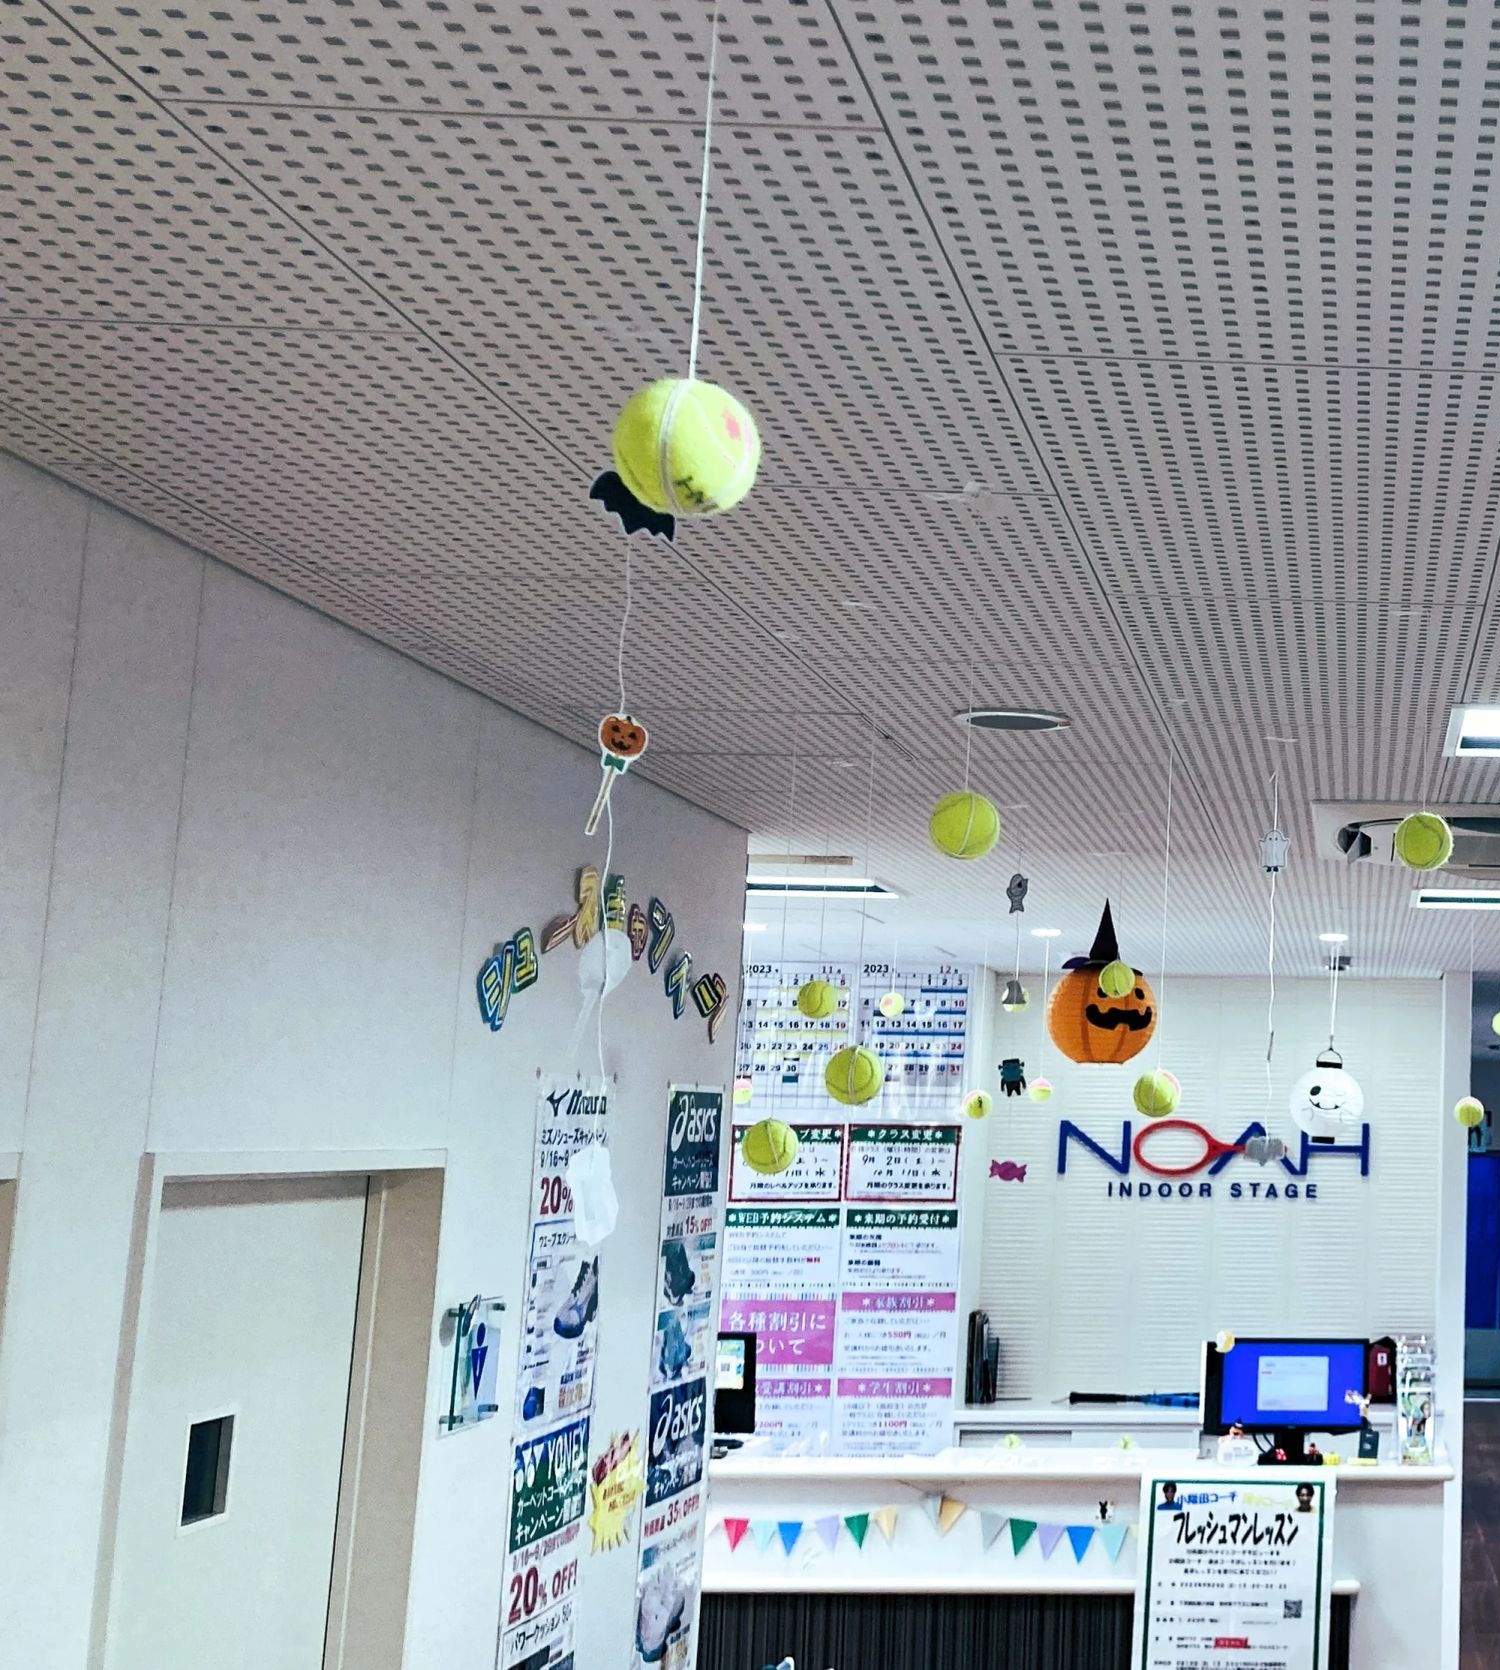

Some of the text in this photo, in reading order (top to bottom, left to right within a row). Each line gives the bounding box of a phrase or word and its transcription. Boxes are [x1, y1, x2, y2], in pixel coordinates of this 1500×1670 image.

[863, 964, 889, 973] 2023
[940, 966, 951, 974] 12
[878, 1128, 933, 1140] クラス変更
[1057, 1119, 1370, 1176] NOAH
[539, 1175, 574, 1216] 20%
[1108, 1182, 1319, 1199] INDOOR STAGE
[738, 1212, 826, 1224] WEB予約システム
[864, 1213, 940, 1225] 来期の予約受付
[729, 1311, 826, 1332] 各種割引に
[1173, 1511, 1299, 1546] フレッシュマンレッスン
[508, 1566, 548, 1625] 20%
